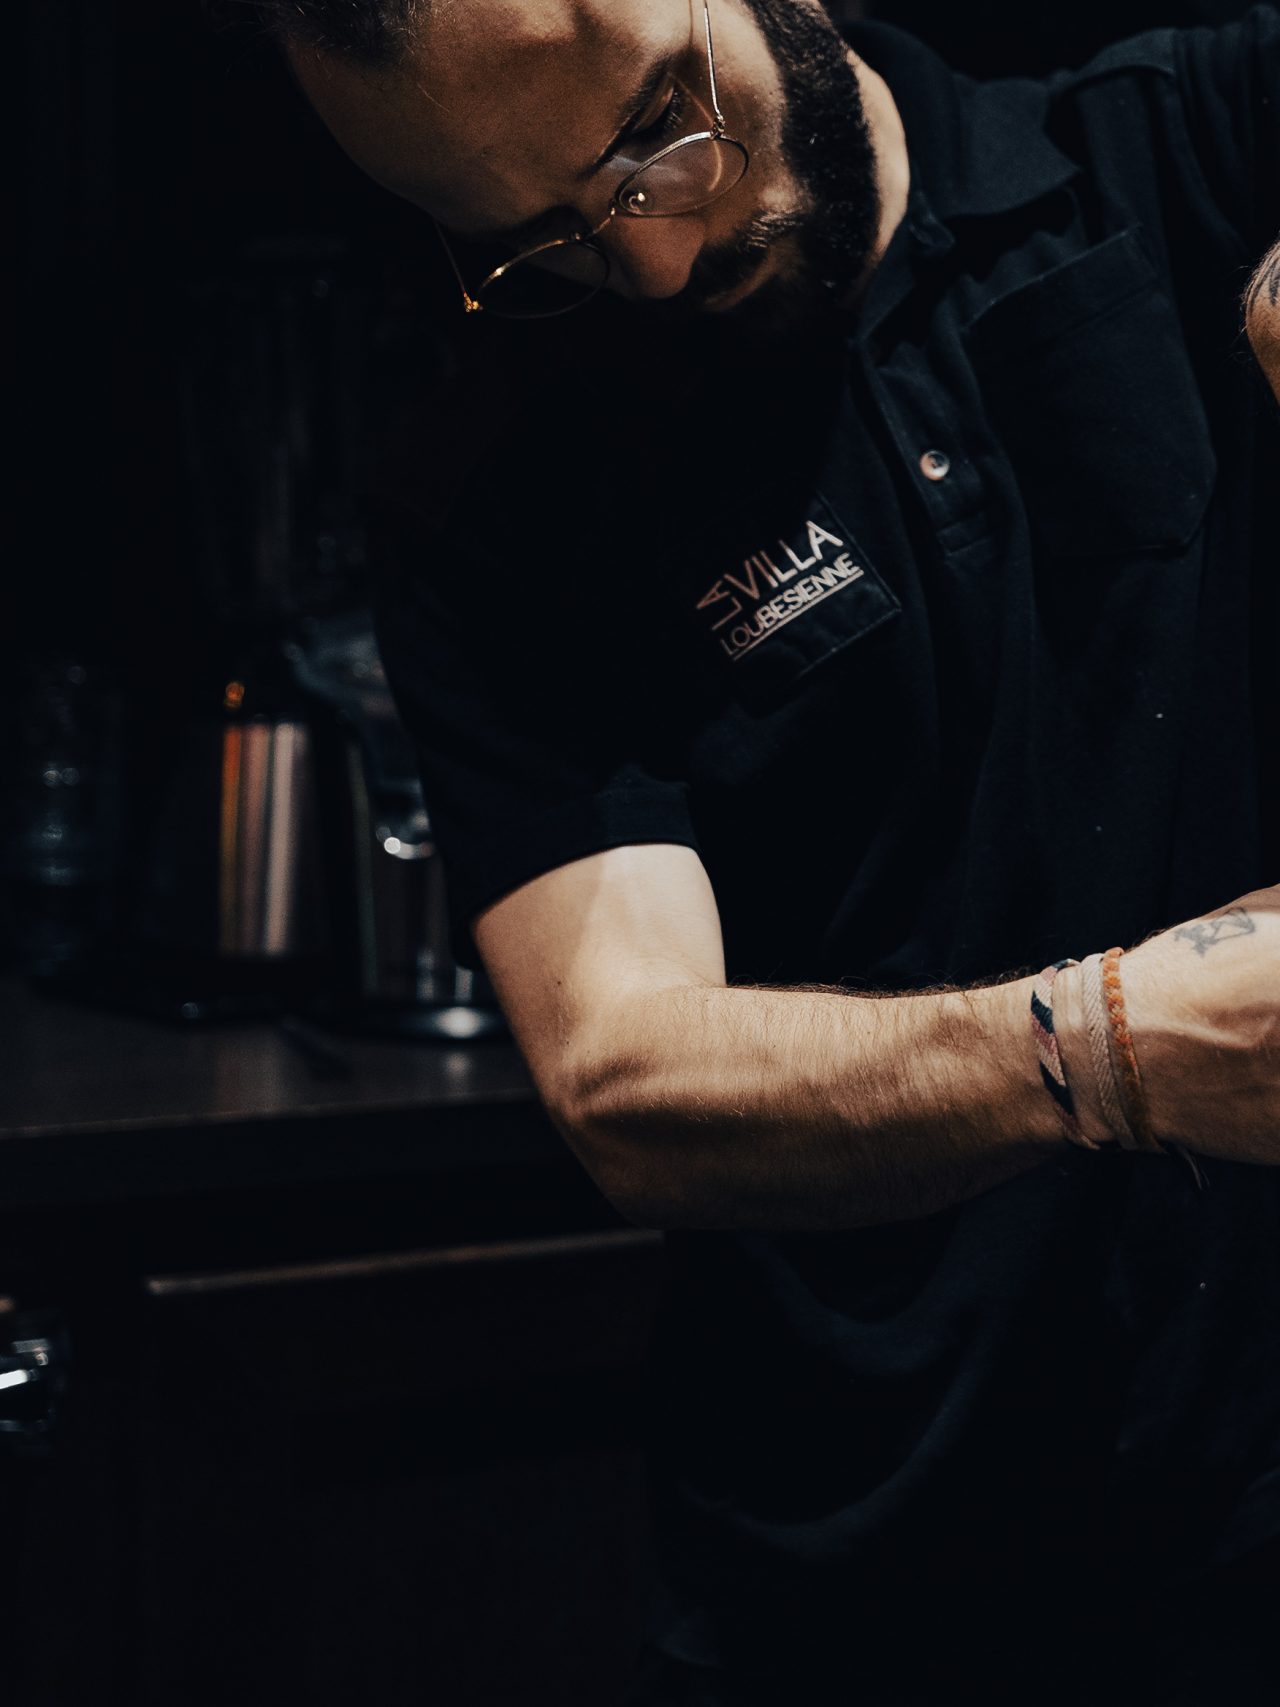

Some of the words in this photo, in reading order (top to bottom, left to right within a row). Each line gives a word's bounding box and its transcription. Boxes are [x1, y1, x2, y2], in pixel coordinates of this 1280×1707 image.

[696, 579, 743, 631] LA
[723, 519, 844, 600] VILLA
[720, 552, 862, 656] LOUBESIENNE
